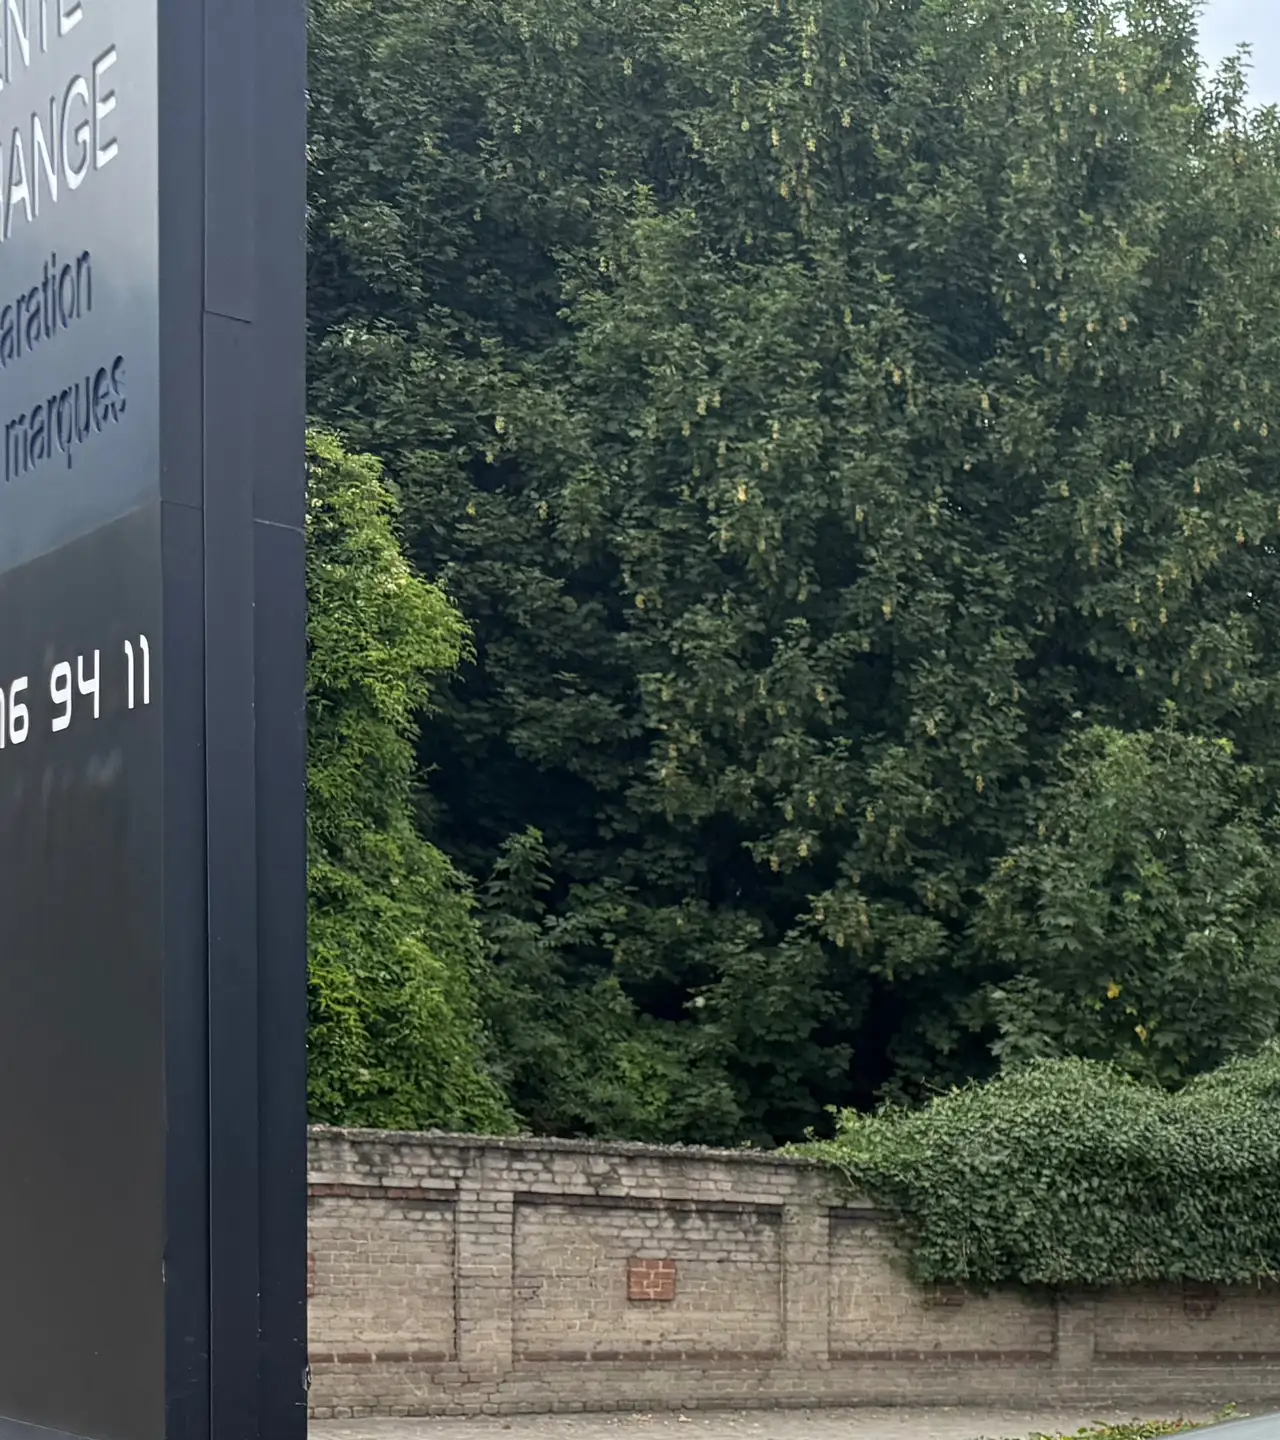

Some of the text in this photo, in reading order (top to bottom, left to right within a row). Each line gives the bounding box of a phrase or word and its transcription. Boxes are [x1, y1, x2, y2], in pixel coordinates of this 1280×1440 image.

[0, 44, 118, 242] ANGE
[5, 355, 127, 482] marques
[50, 649, 100, 733] 94
[124, 634, 150, 710] 11
